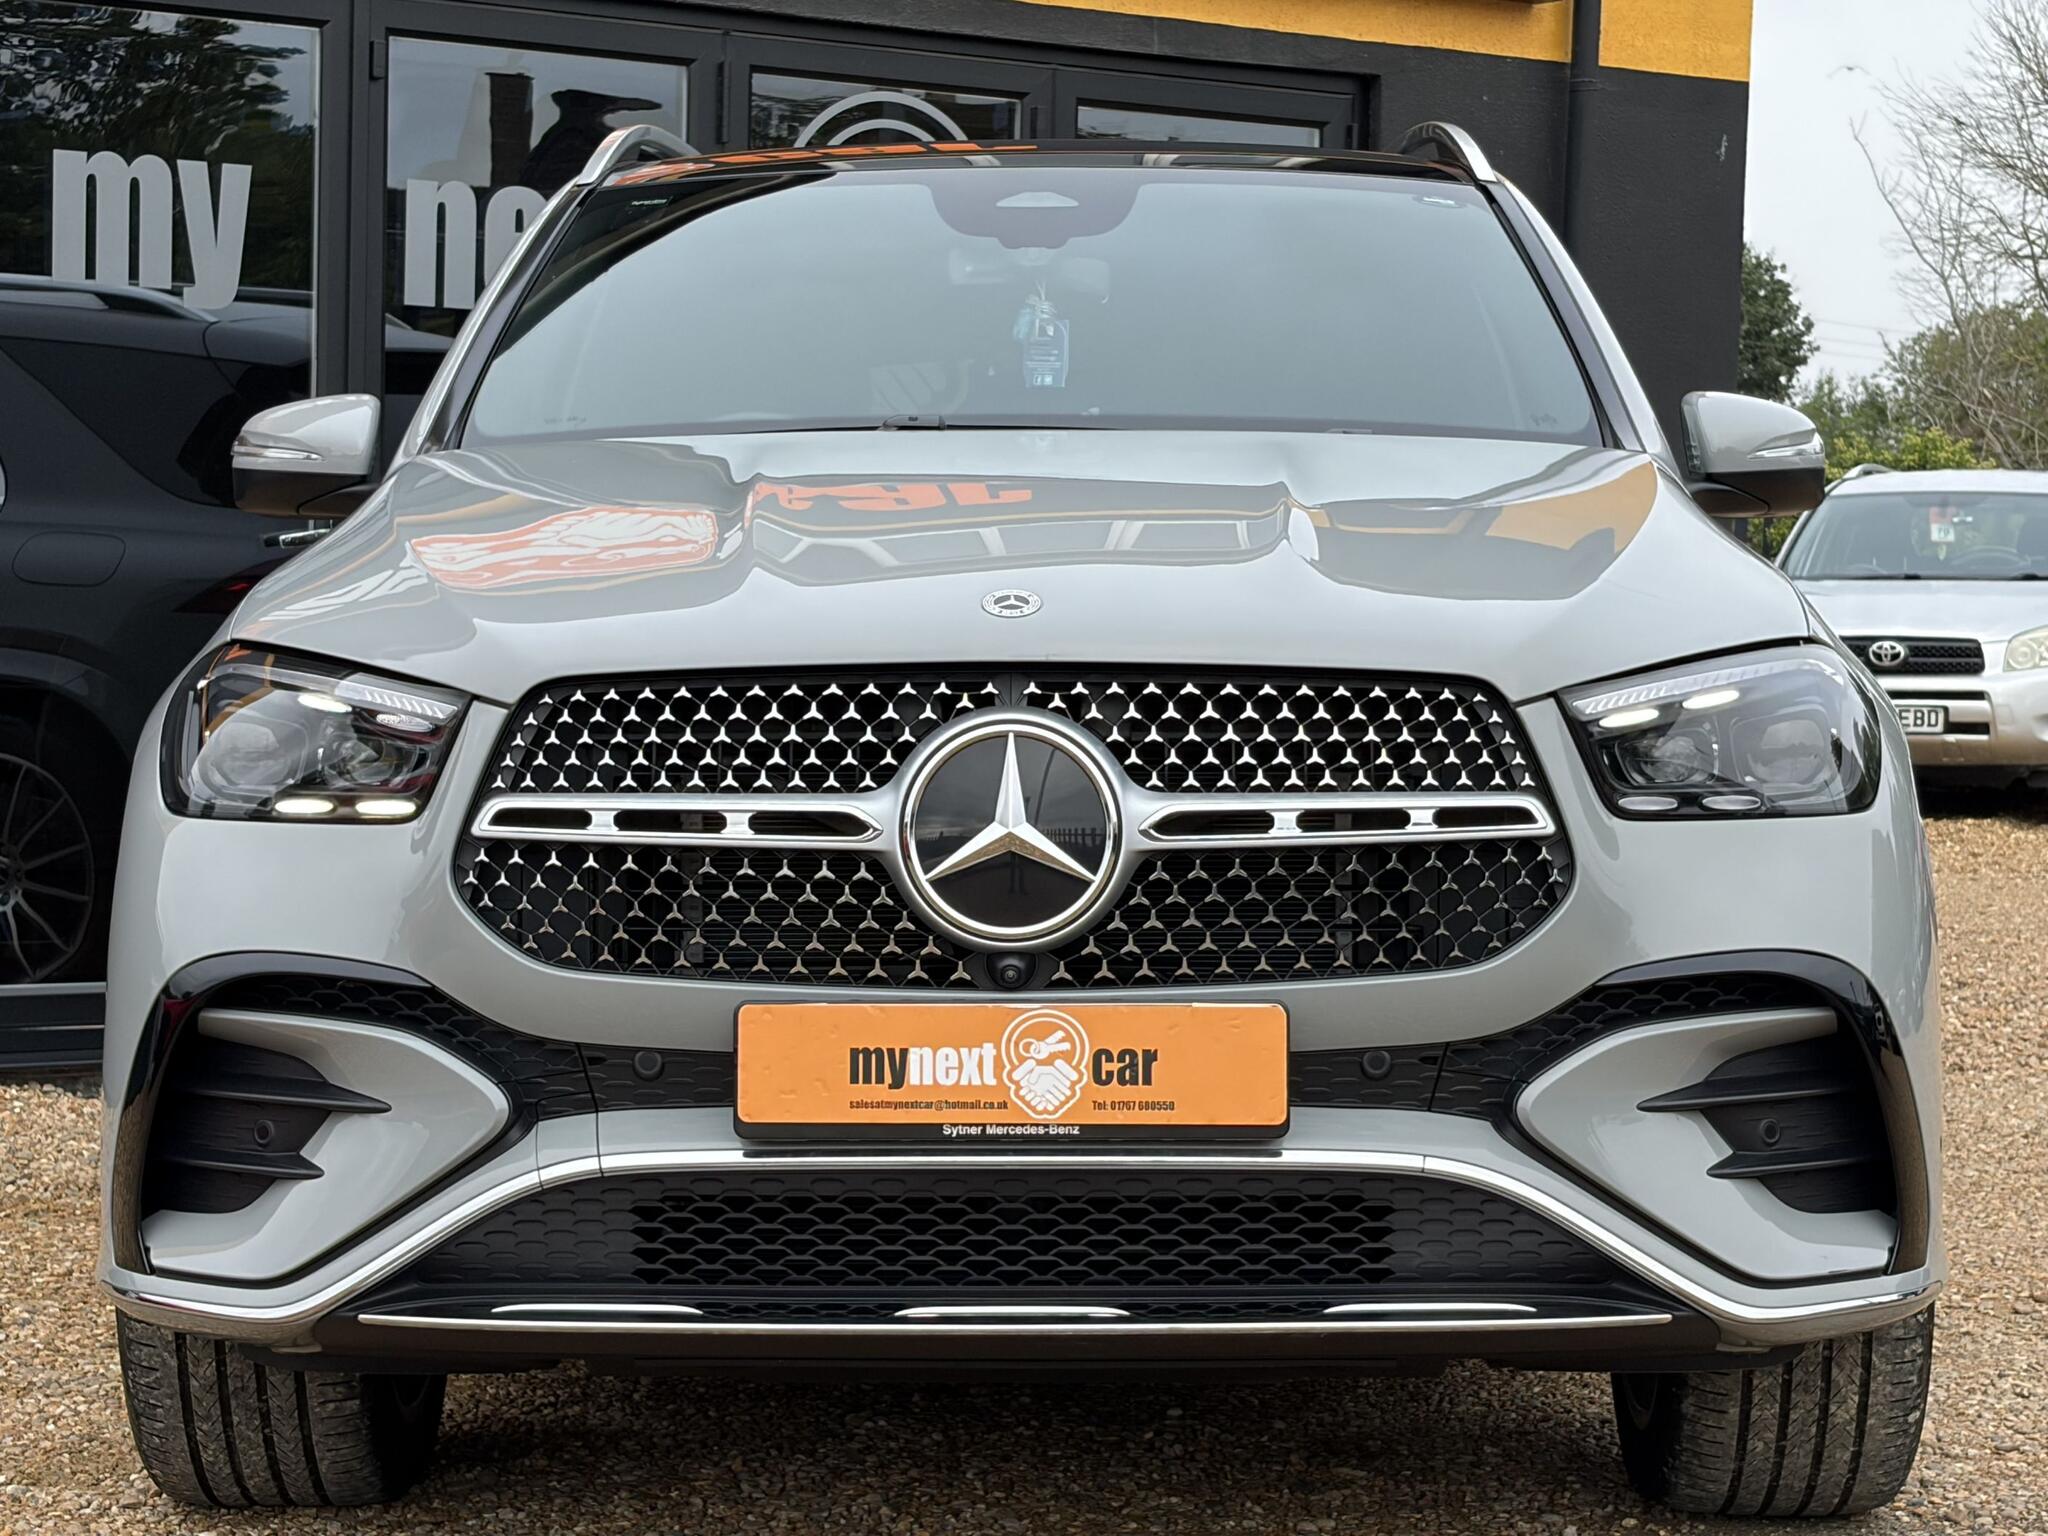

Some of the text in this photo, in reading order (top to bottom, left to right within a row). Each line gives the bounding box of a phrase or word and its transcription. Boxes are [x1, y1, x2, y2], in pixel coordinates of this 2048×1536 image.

[52, 148, 253, 310] my
[1899, 708, 1939, 728] EBD
[1092, 1048, 1158, 1087] car
[849, 1099, 1009, 1112] salesatmynextcar@hotmail.co.uk
[1092, 1100, 1109, 1111] Tel:
[1110, 1100, 1136, 1111] 01767
[942, 1124, 1080, 1137] Sytner Mercedes-Benz
